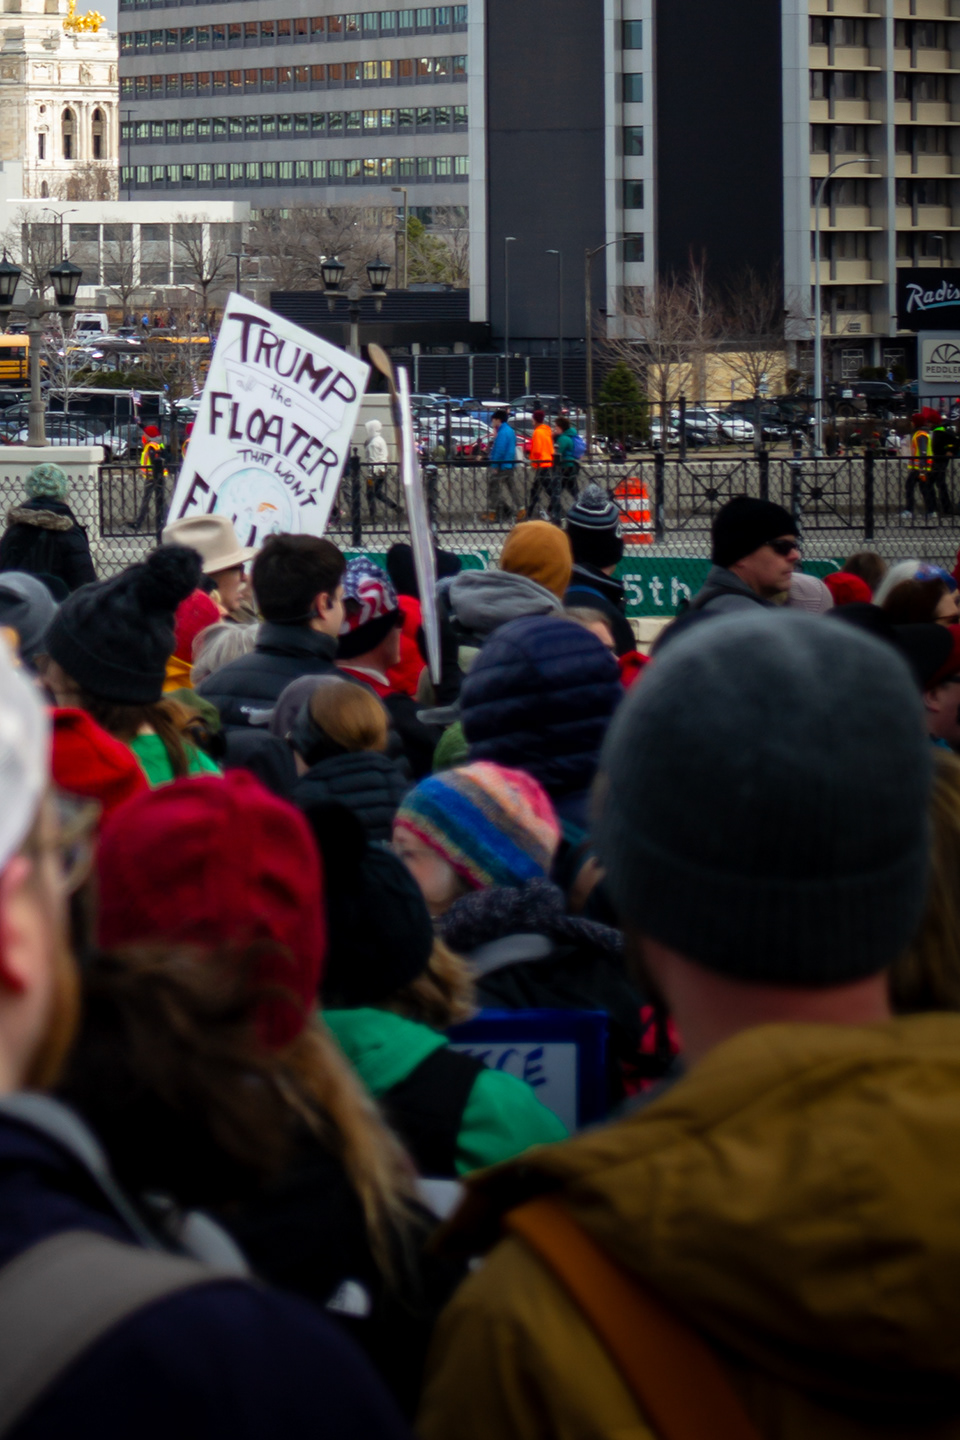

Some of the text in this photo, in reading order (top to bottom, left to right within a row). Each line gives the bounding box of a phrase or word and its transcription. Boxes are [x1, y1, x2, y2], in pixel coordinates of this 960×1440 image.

[228, 313, 357, 403] TRUMP
[269, 384, 292, 407] the
[209, 391, 339, 493] FLOATER
[236, 449, 318, 507] THAT WON'T
[622, 574, 691, 607] 5th
